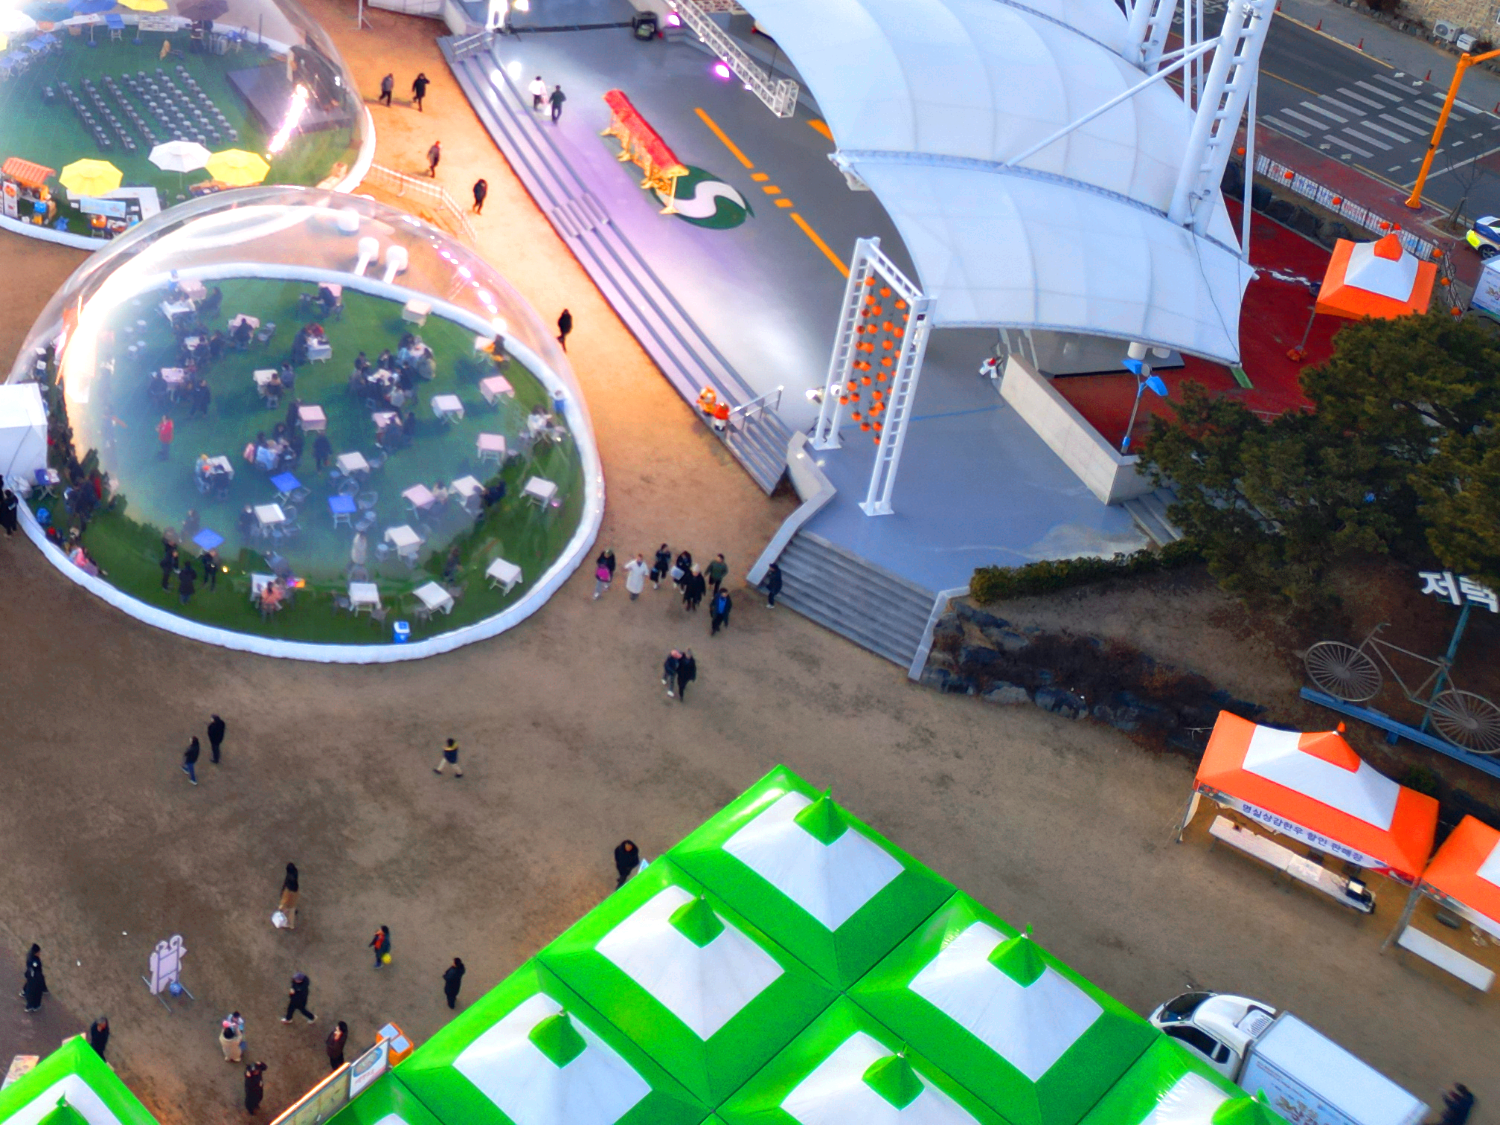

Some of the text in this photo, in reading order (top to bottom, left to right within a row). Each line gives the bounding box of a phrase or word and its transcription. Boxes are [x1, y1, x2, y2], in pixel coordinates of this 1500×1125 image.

[1242, 803, 1364, 862] 명실상감한우 할인 판매장
